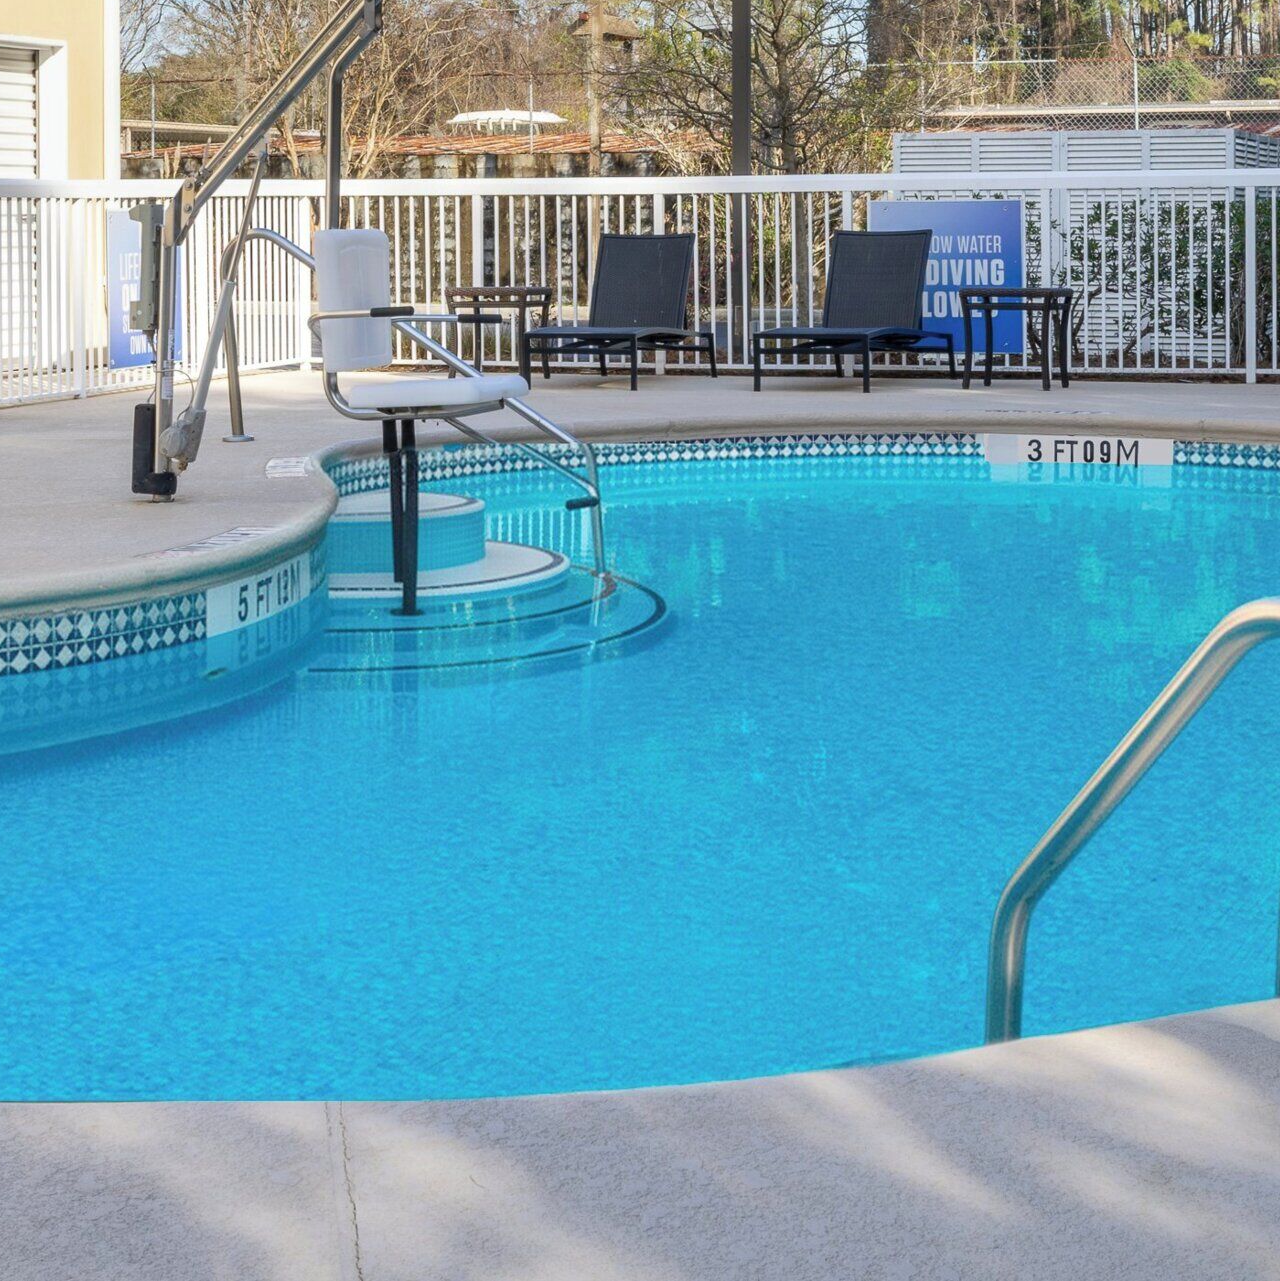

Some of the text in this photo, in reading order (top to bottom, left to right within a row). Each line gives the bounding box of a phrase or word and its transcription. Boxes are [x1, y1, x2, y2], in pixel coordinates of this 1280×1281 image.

[957, 234, 1002, 254] WATER
[925, 258, 1005, 286] DIVING
[1027, 439, 1042, 462] 3
[1054, 439, 1078, 462] FT
[1117, 439, 1139, 468] M
[238, 584, 248, 622] 5
[256, 576, 272, 617] FT
